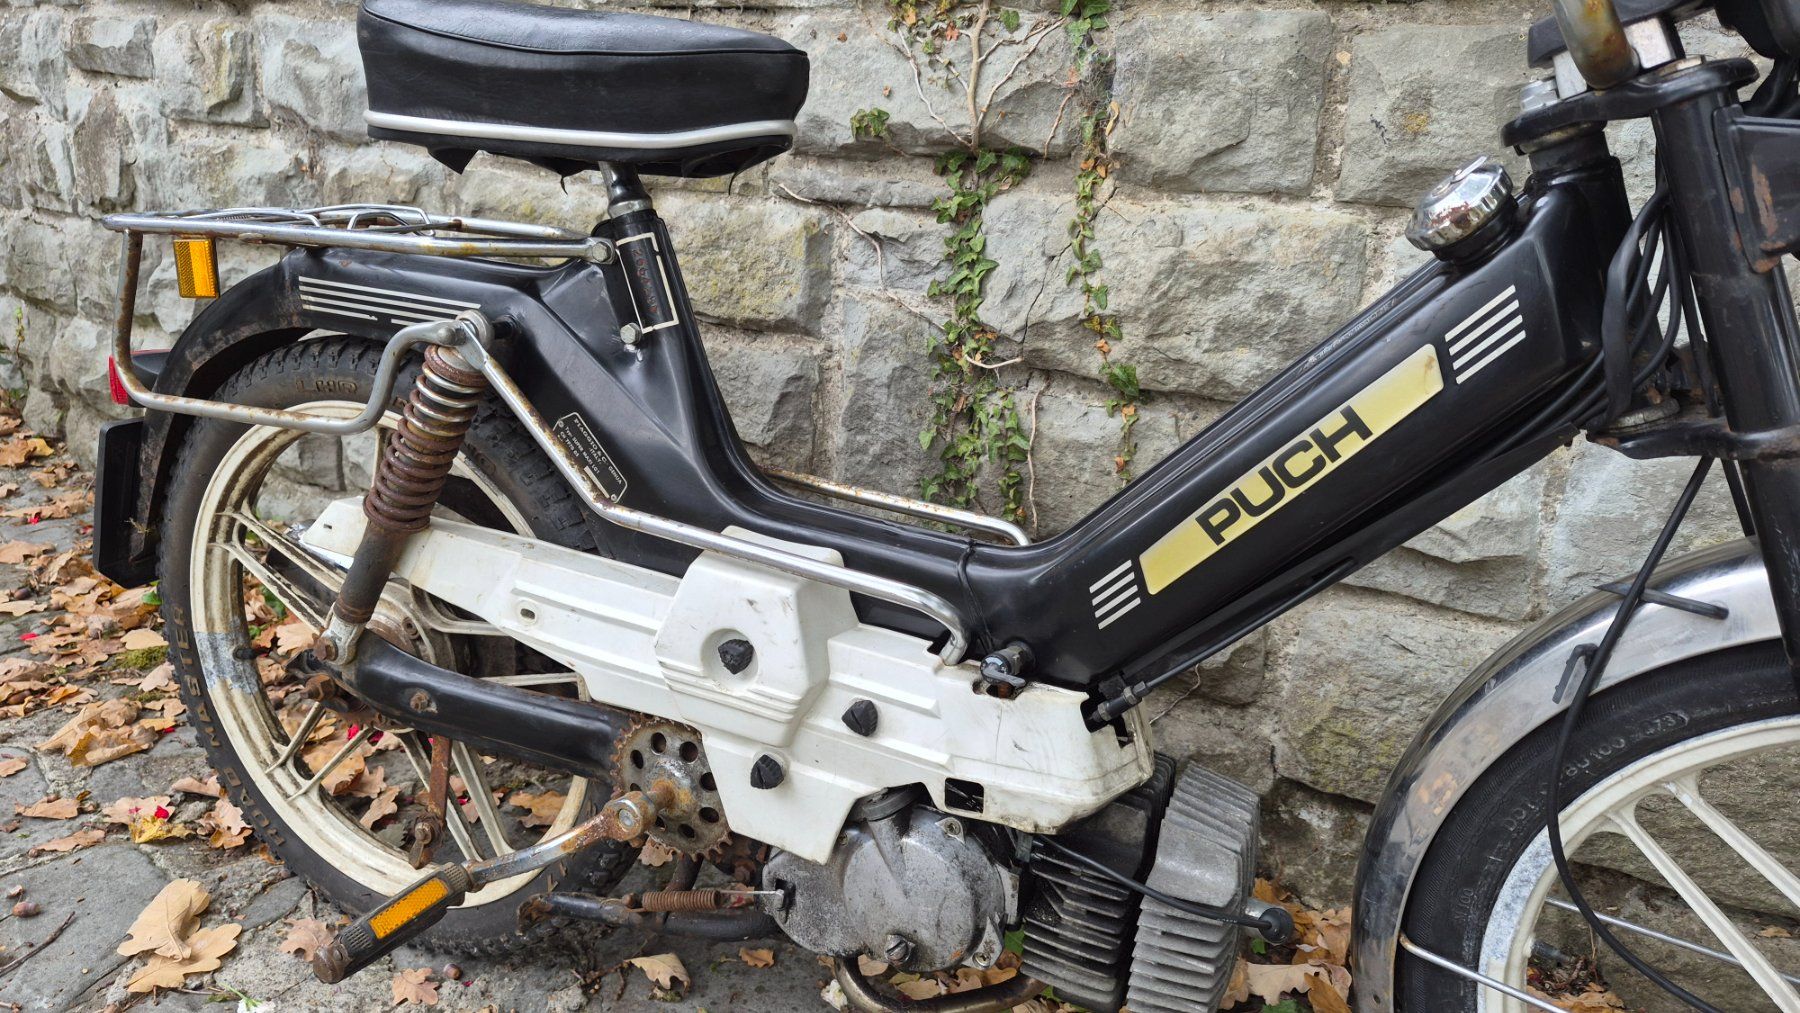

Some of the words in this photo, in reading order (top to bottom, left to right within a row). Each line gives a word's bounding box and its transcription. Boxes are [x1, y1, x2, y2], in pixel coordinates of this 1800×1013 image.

[572, 436, 584, 452] SUPER
[582, 451, 593, 465] MAXI
[573, 418, 598, 451] PIAGGIO
[608, 465, 622, 484] GENUA
[1195, 404, 1374, 546] PUCH
[173, 605, 221, 747] MASTER
[223, 766, 287, 847] ROAD
